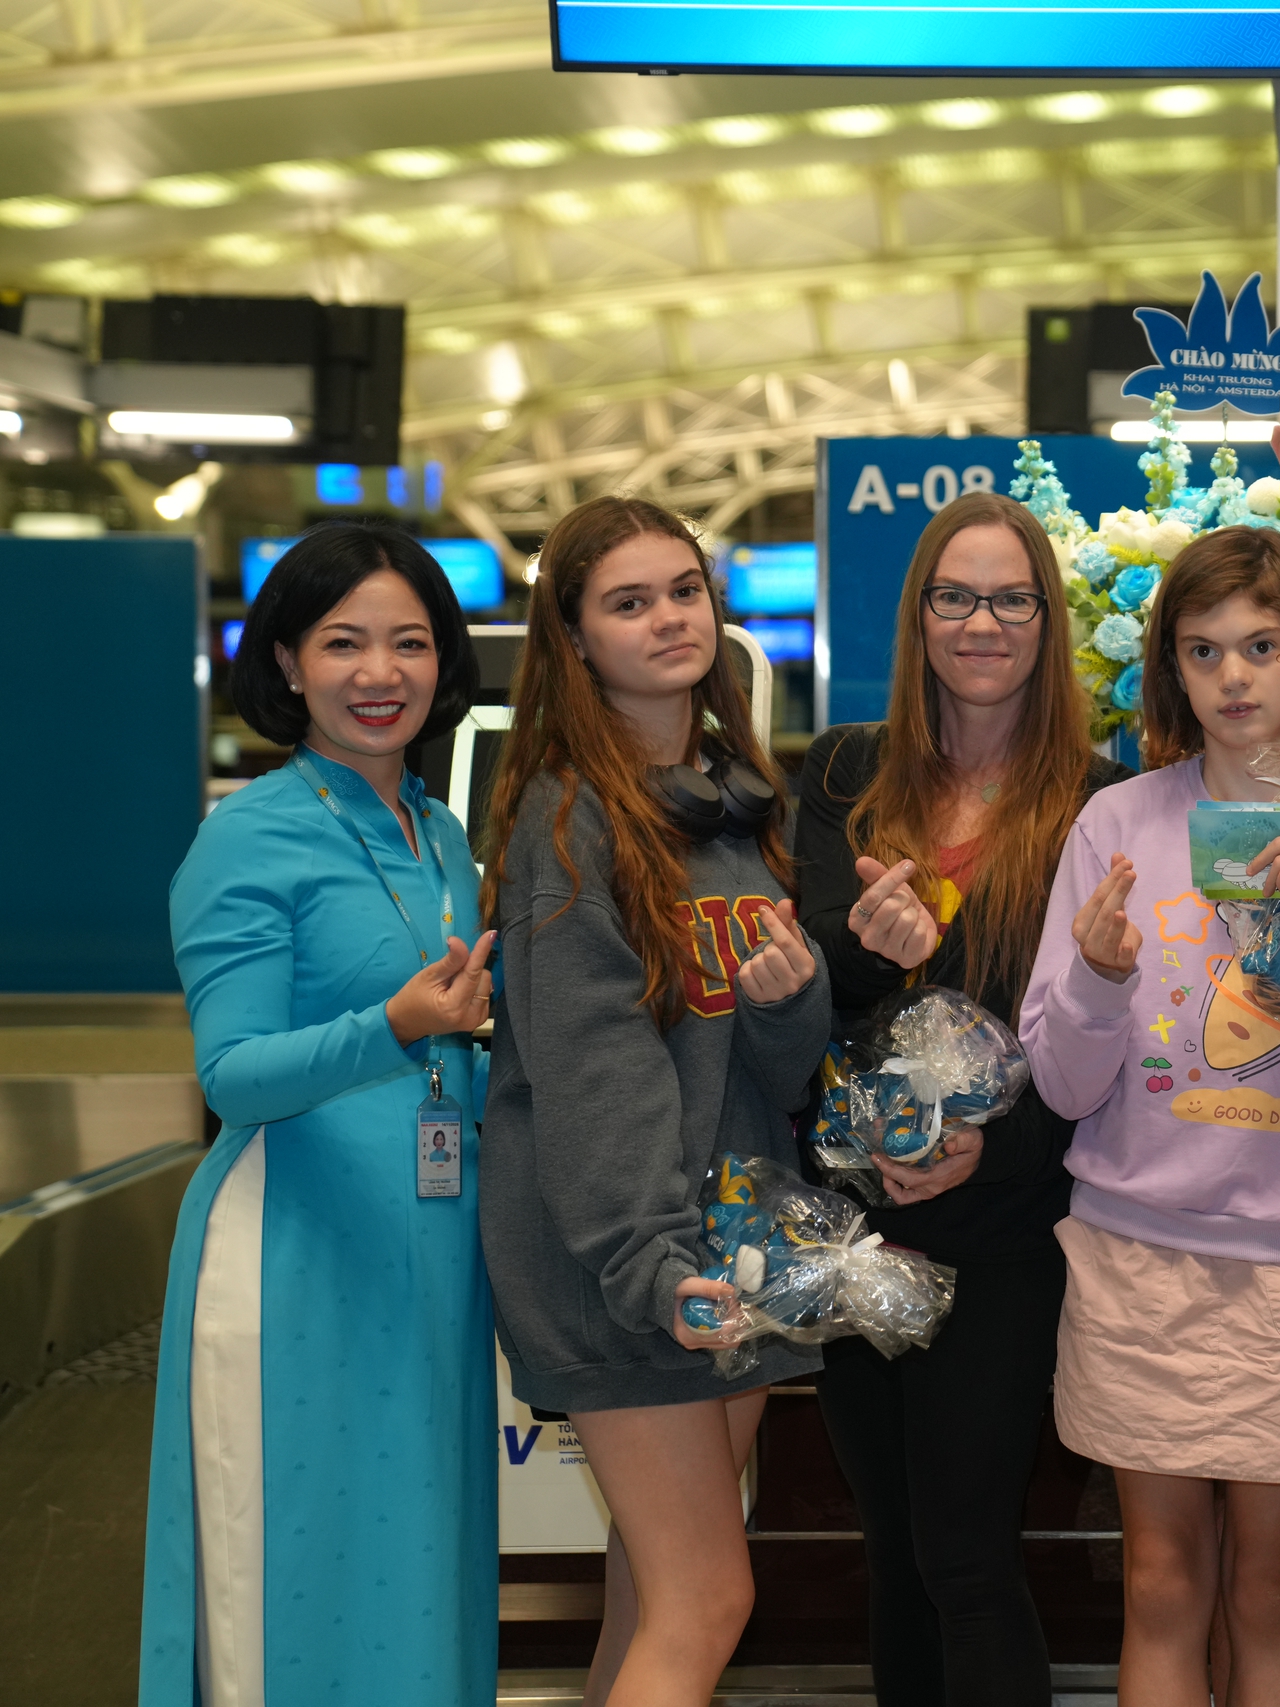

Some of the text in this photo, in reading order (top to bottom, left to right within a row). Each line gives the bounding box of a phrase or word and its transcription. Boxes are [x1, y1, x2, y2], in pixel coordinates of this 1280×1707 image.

[1169, 346, 1226, 368] CHÀO
[1183, 373, 1215, 384] KHAI
[1159, 382, 1180, 392] HÀ
[1182, 383, 1206, 394] NỘI
[1213, 1105, 1263, 1123] GOOD
